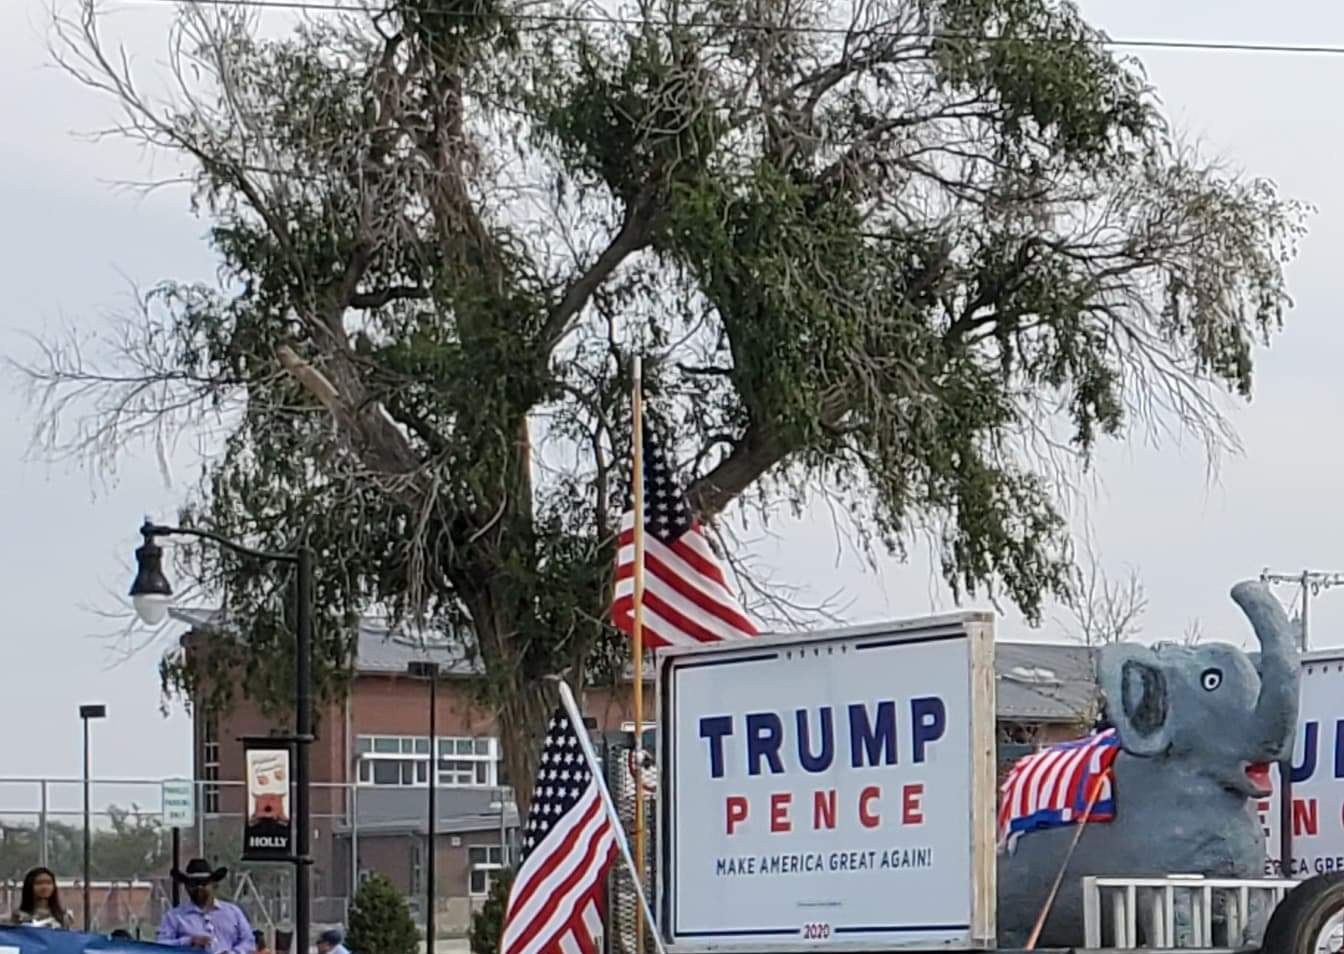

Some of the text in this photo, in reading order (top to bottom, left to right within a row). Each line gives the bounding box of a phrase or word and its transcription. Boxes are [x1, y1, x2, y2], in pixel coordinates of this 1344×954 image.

[699, 696, 946, 778] TRUMP
[726, 783, 924, 835] PENCE
[249, 837, 287, 847] HOLLY
[716, 847, 932, 876] MAKE AMERICA GREAT AGAIN!
[803, 924, 830, 938] 2020
